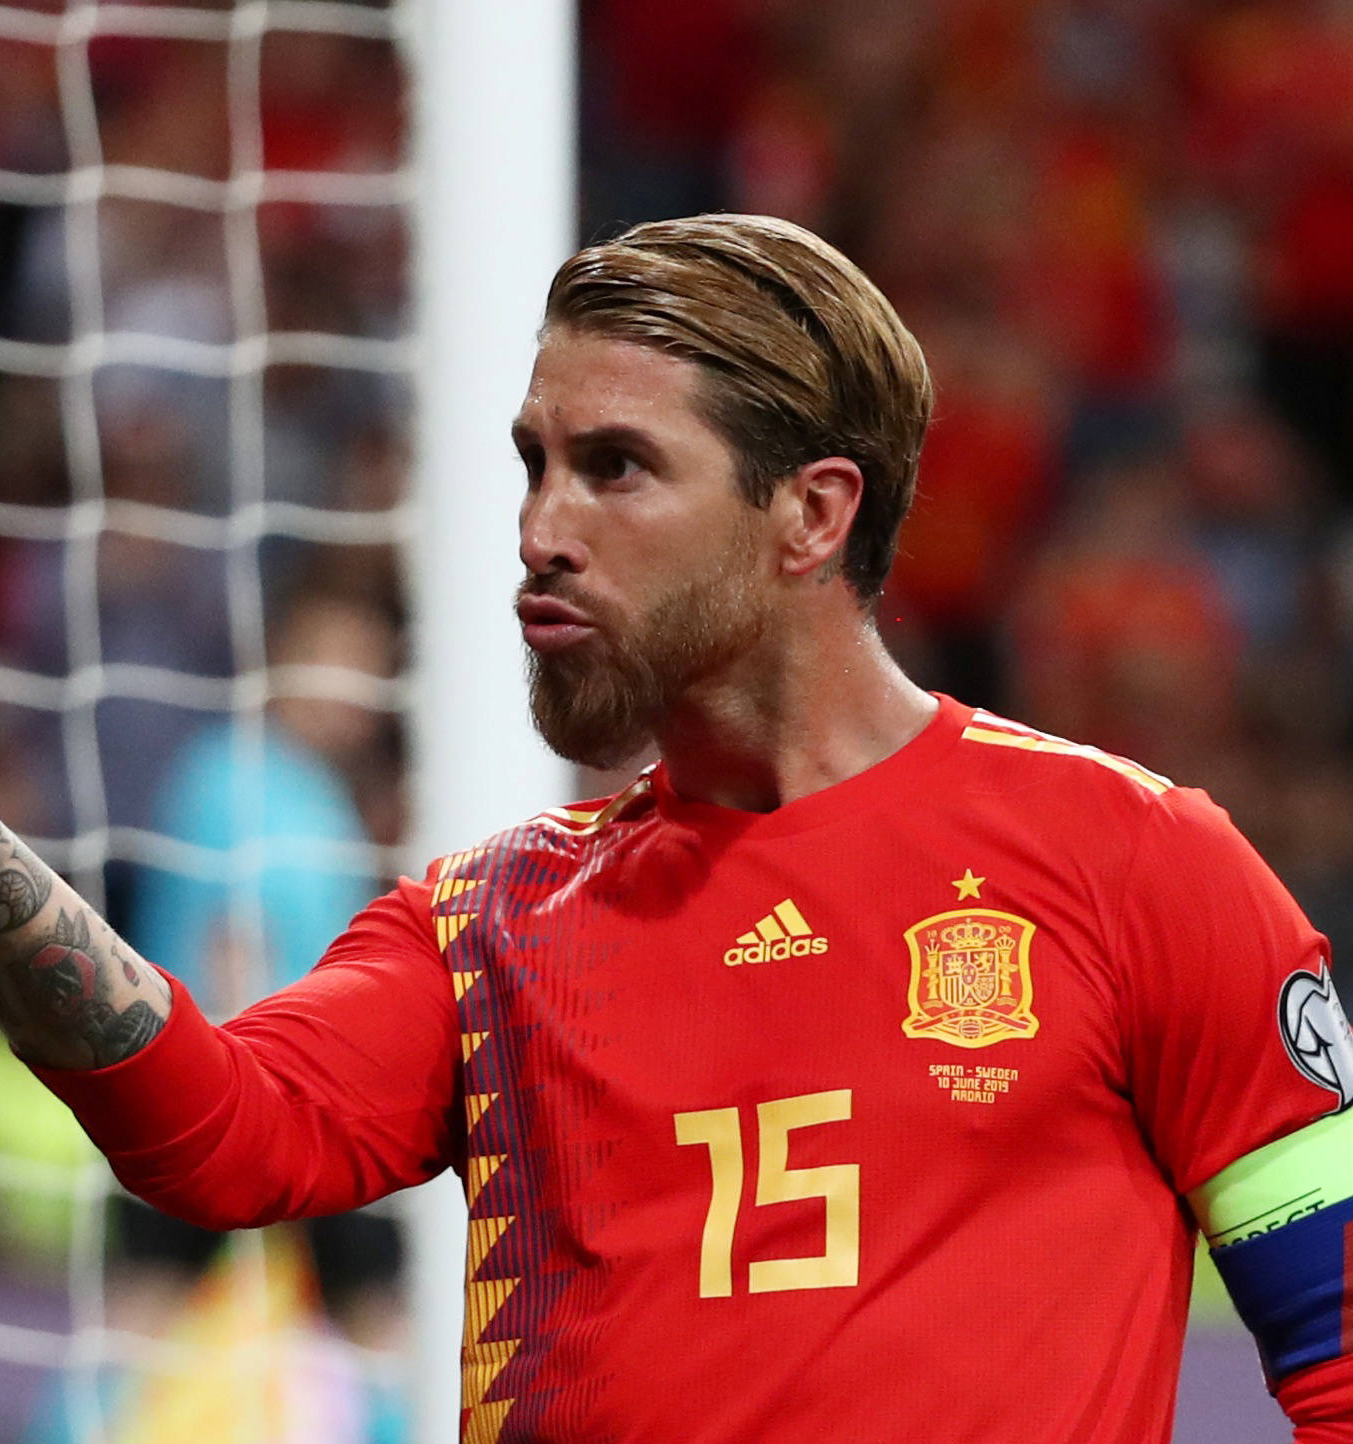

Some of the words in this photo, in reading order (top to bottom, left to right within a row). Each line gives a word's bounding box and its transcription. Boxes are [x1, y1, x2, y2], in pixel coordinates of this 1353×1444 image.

[724, 936, 828, 966] adidas
[929, 1065, 964, 1077] SPAIN
[975, 1066, 1018, 1081] SWEDEN
[938, 1077, 950, 1089] 10
[953, 1078, 980, 1090] JUNE
[984, 1080, 1009, 1093] 2019
[951, 1090, 995, 1104] MADRID
[673, 1088, 860, 1298] 15
